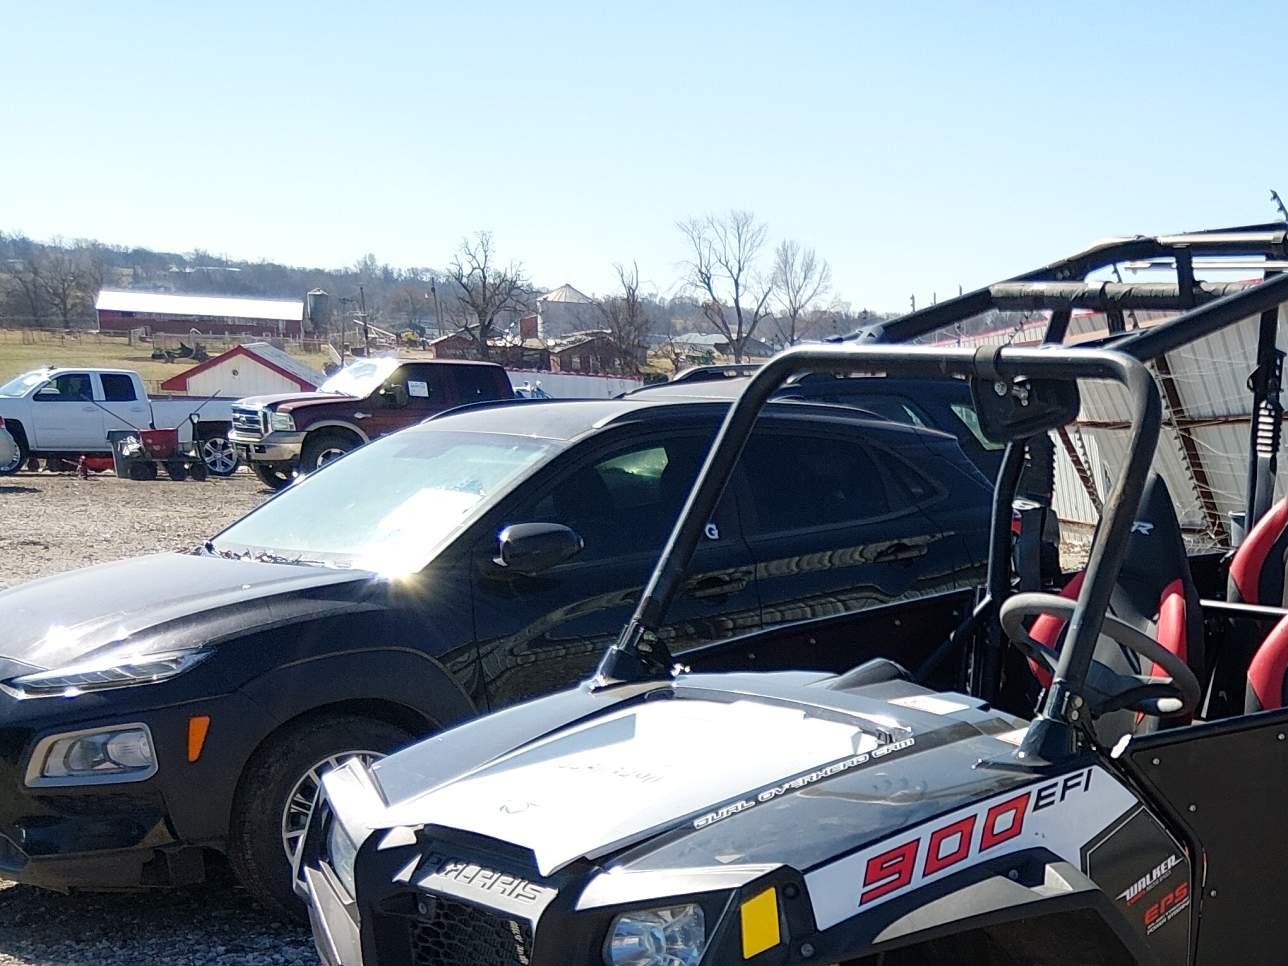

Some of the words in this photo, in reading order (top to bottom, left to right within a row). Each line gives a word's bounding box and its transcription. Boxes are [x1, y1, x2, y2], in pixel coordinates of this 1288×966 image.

[693, 799, 756, 830] DUAL
[757, 753, 870, 803] OVERHEAD
[871, 737, 916, 759] CAM
[858, 790, 1033, 908] 900
[1032, 768, 1094, 813] EFI
[419, 853, 545, 903] POLARIS
[1114, 854, 1185, 903] WALKER
[1144, 881, 1189, 926] EPS
